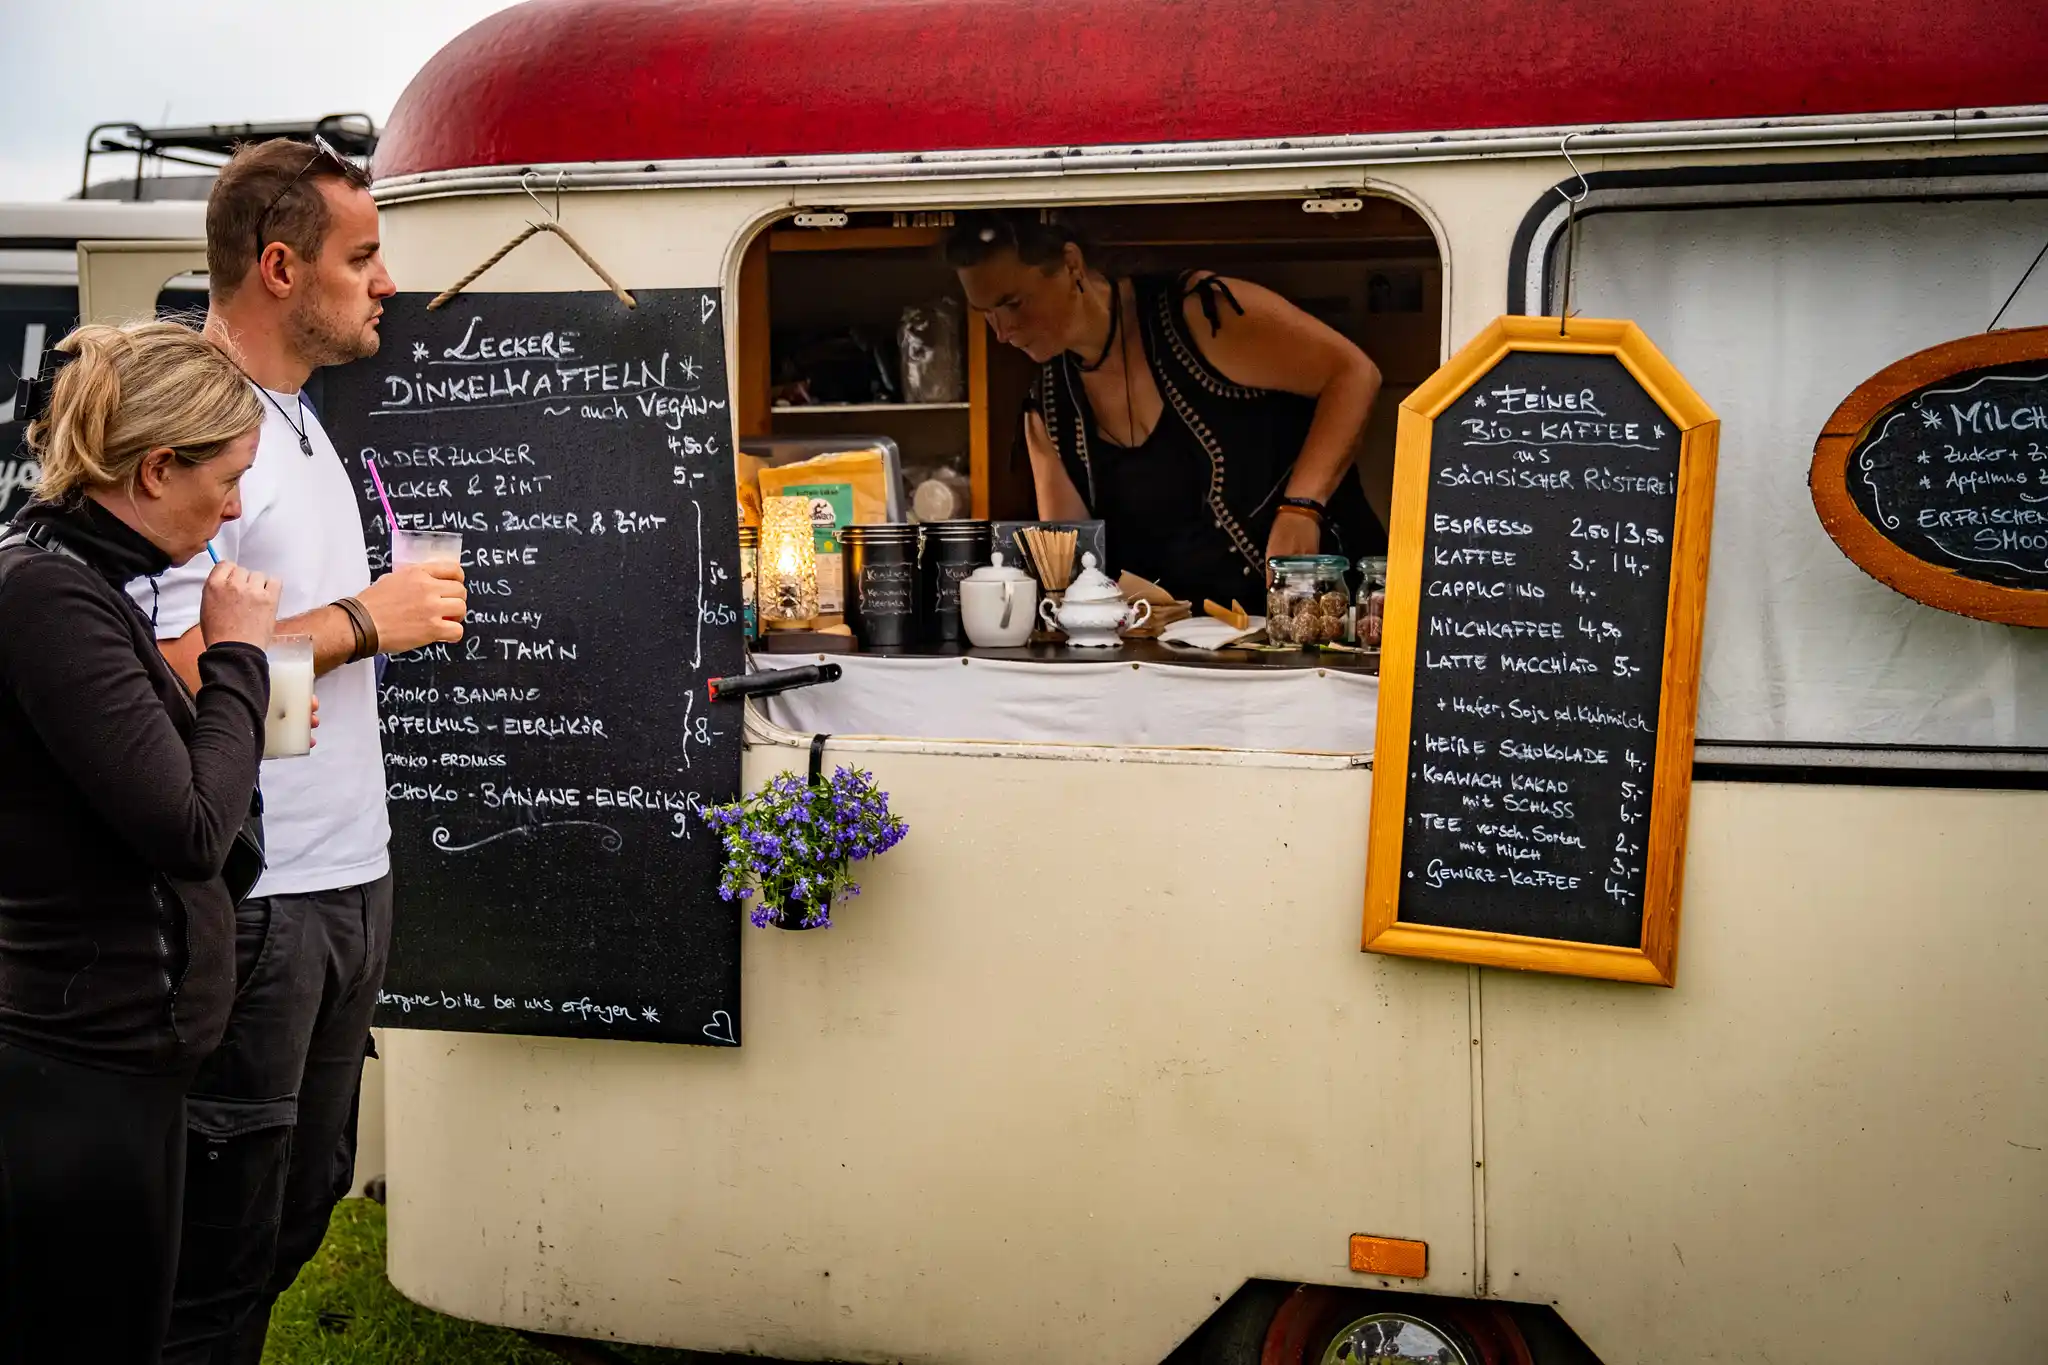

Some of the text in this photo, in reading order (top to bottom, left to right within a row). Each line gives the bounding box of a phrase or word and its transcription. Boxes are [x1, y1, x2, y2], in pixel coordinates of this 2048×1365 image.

[581, 397, 628, 419] auch
[1512, 449, 1550, 463] aus
[467, 474, 482, 496] &
[1974, 528, 2048, 550] SMOO
[465, 636, 488, 660] &
[1426, 650, 1487, 670] LATTE
[384, 753, 428, 767] CHOKO
[386, 783, 458, 802] CHOKO
[1462, 795, 1494, 808] mit
[1420, 813, 1462, 832] TEE
[1459, 842, 1487, 854] mit
[376, 988, 637, 1023] llergene bitte bei uns erfragen
